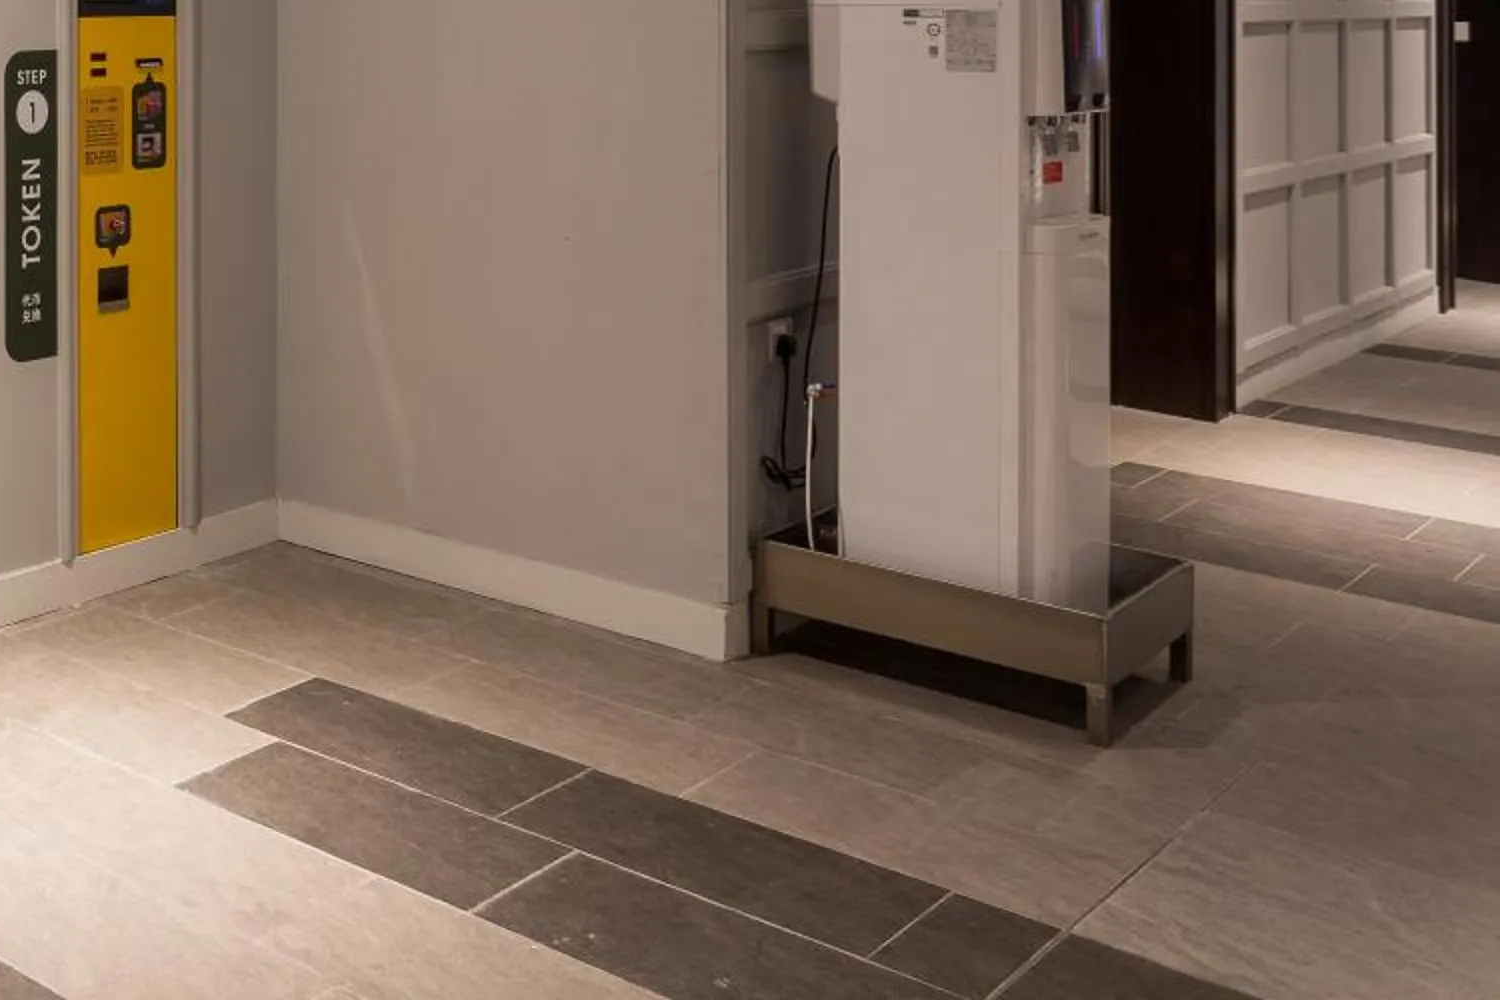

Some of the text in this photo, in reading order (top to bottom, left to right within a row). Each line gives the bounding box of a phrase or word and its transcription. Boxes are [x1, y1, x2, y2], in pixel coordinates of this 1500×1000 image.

[16, 69, 47, 85] STEP
[29, 101, 35, 124] 1
[21, 158, 41, 269] TOKEN
